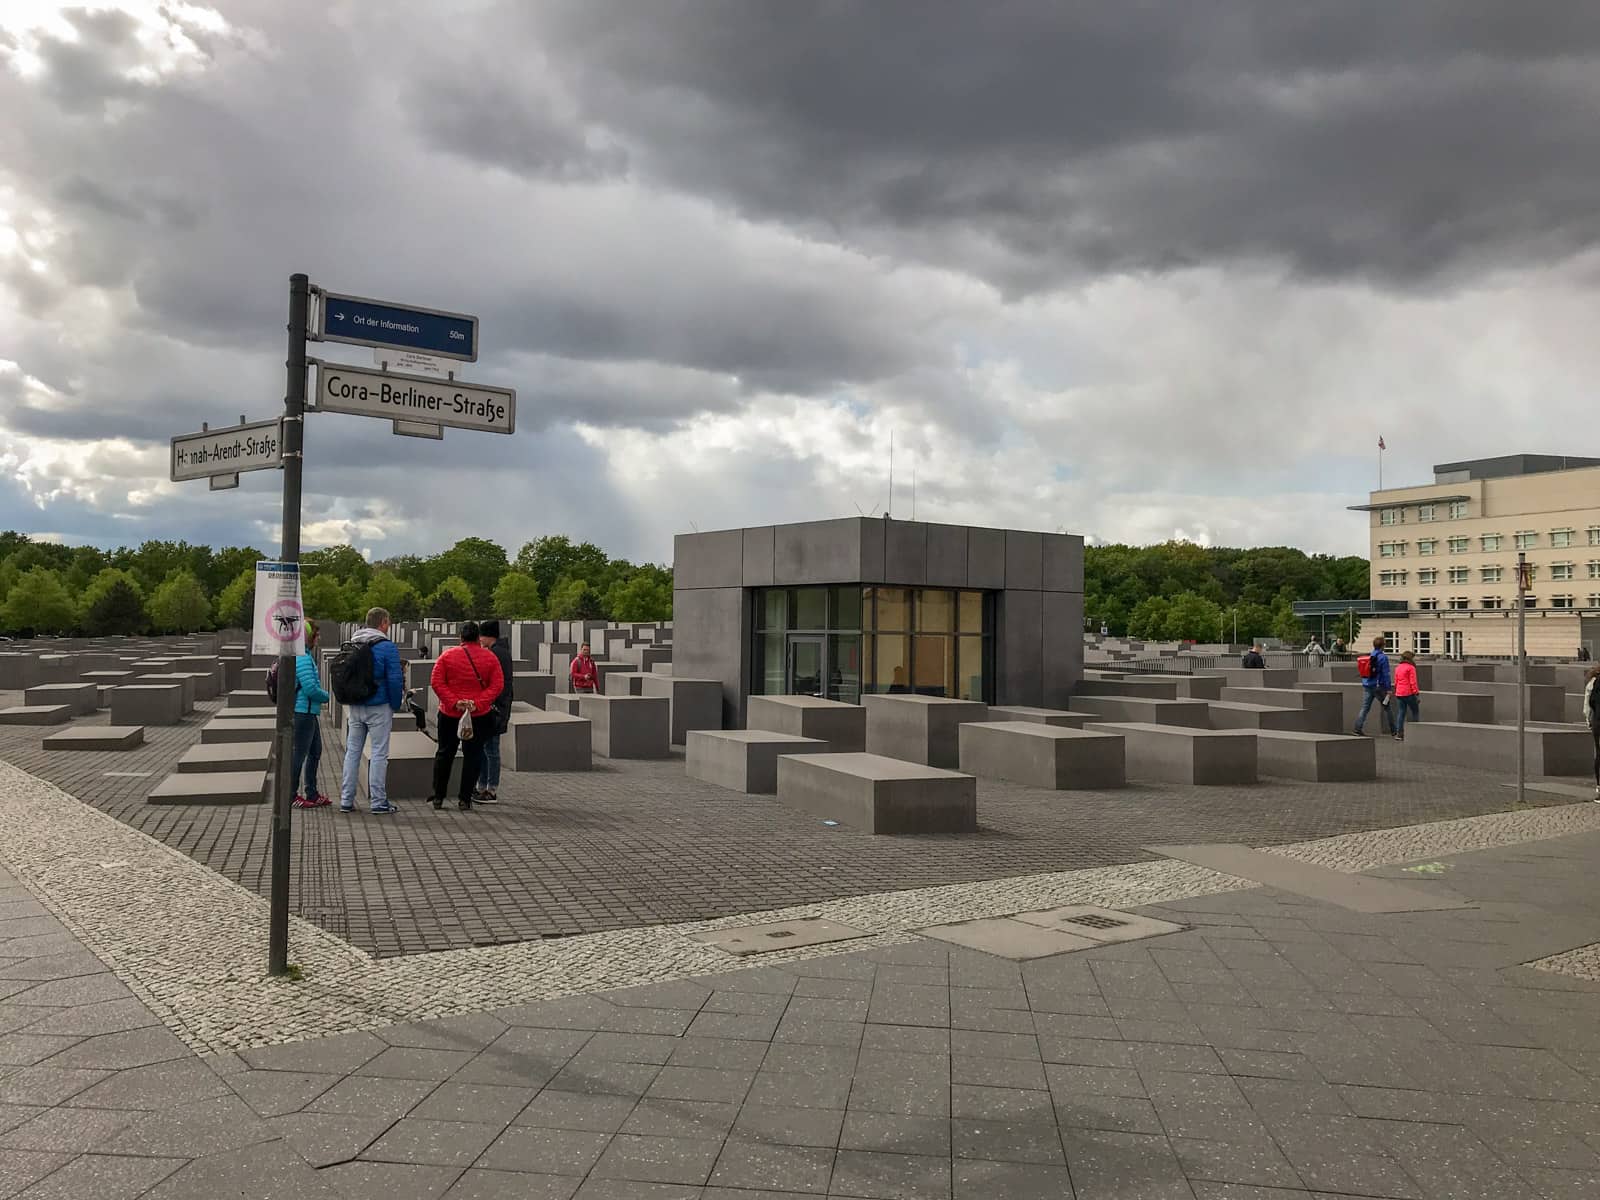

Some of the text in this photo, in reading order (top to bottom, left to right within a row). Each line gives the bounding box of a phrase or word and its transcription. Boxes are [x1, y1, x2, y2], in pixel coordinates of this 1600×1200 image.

[353, 315, 420, 333] Ort der Information
[449, 330, 465, 341] 50m
[327, 376, 505, 423] Cora-Berliner-Straße
